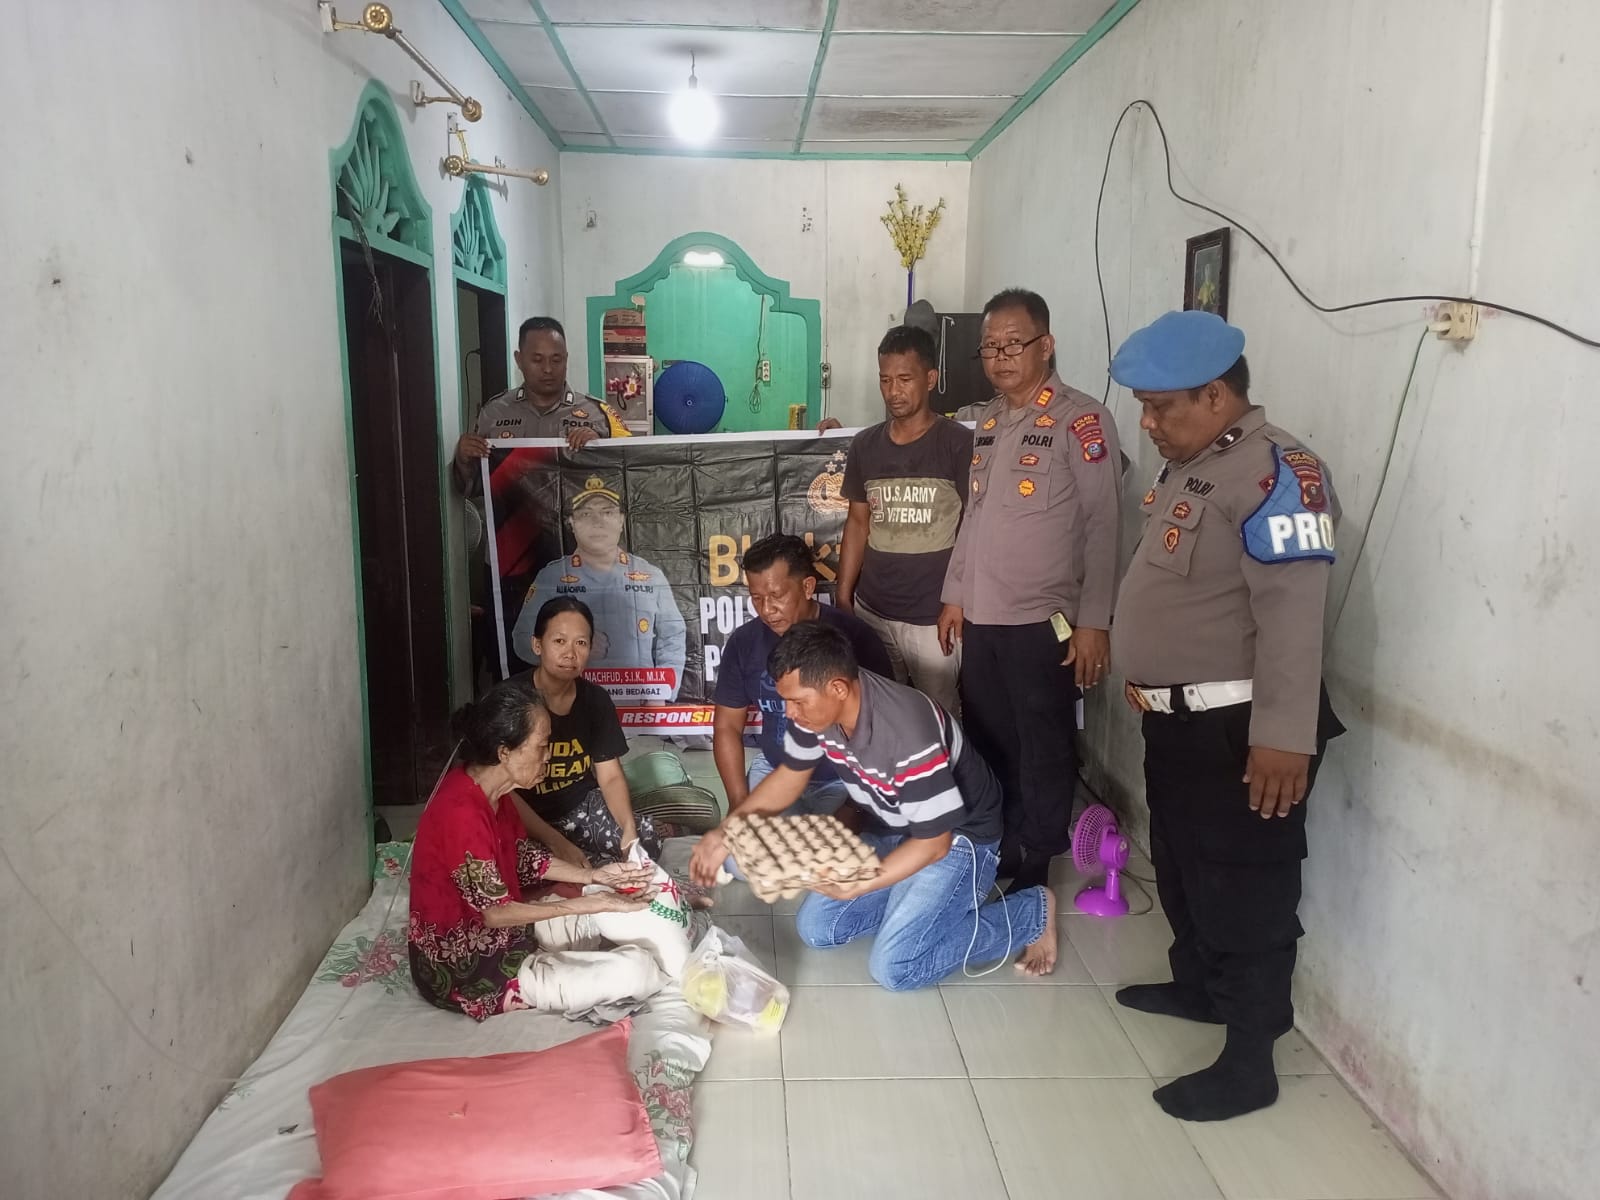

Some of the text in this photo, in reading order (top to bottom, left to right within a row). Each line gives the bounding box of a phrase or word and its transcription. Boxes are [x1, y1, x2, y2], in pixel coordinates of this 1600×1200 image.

[496, 418, 522, 427] UDIN
[1021, 434, 1053, 448] POLRI
[903, 486, 937, 503] ARMY
[1184, 477, 1215, 497] POLRI
[1268, 512, 1335, 555] PRO
[625, 584, 653, 594] POLRI
